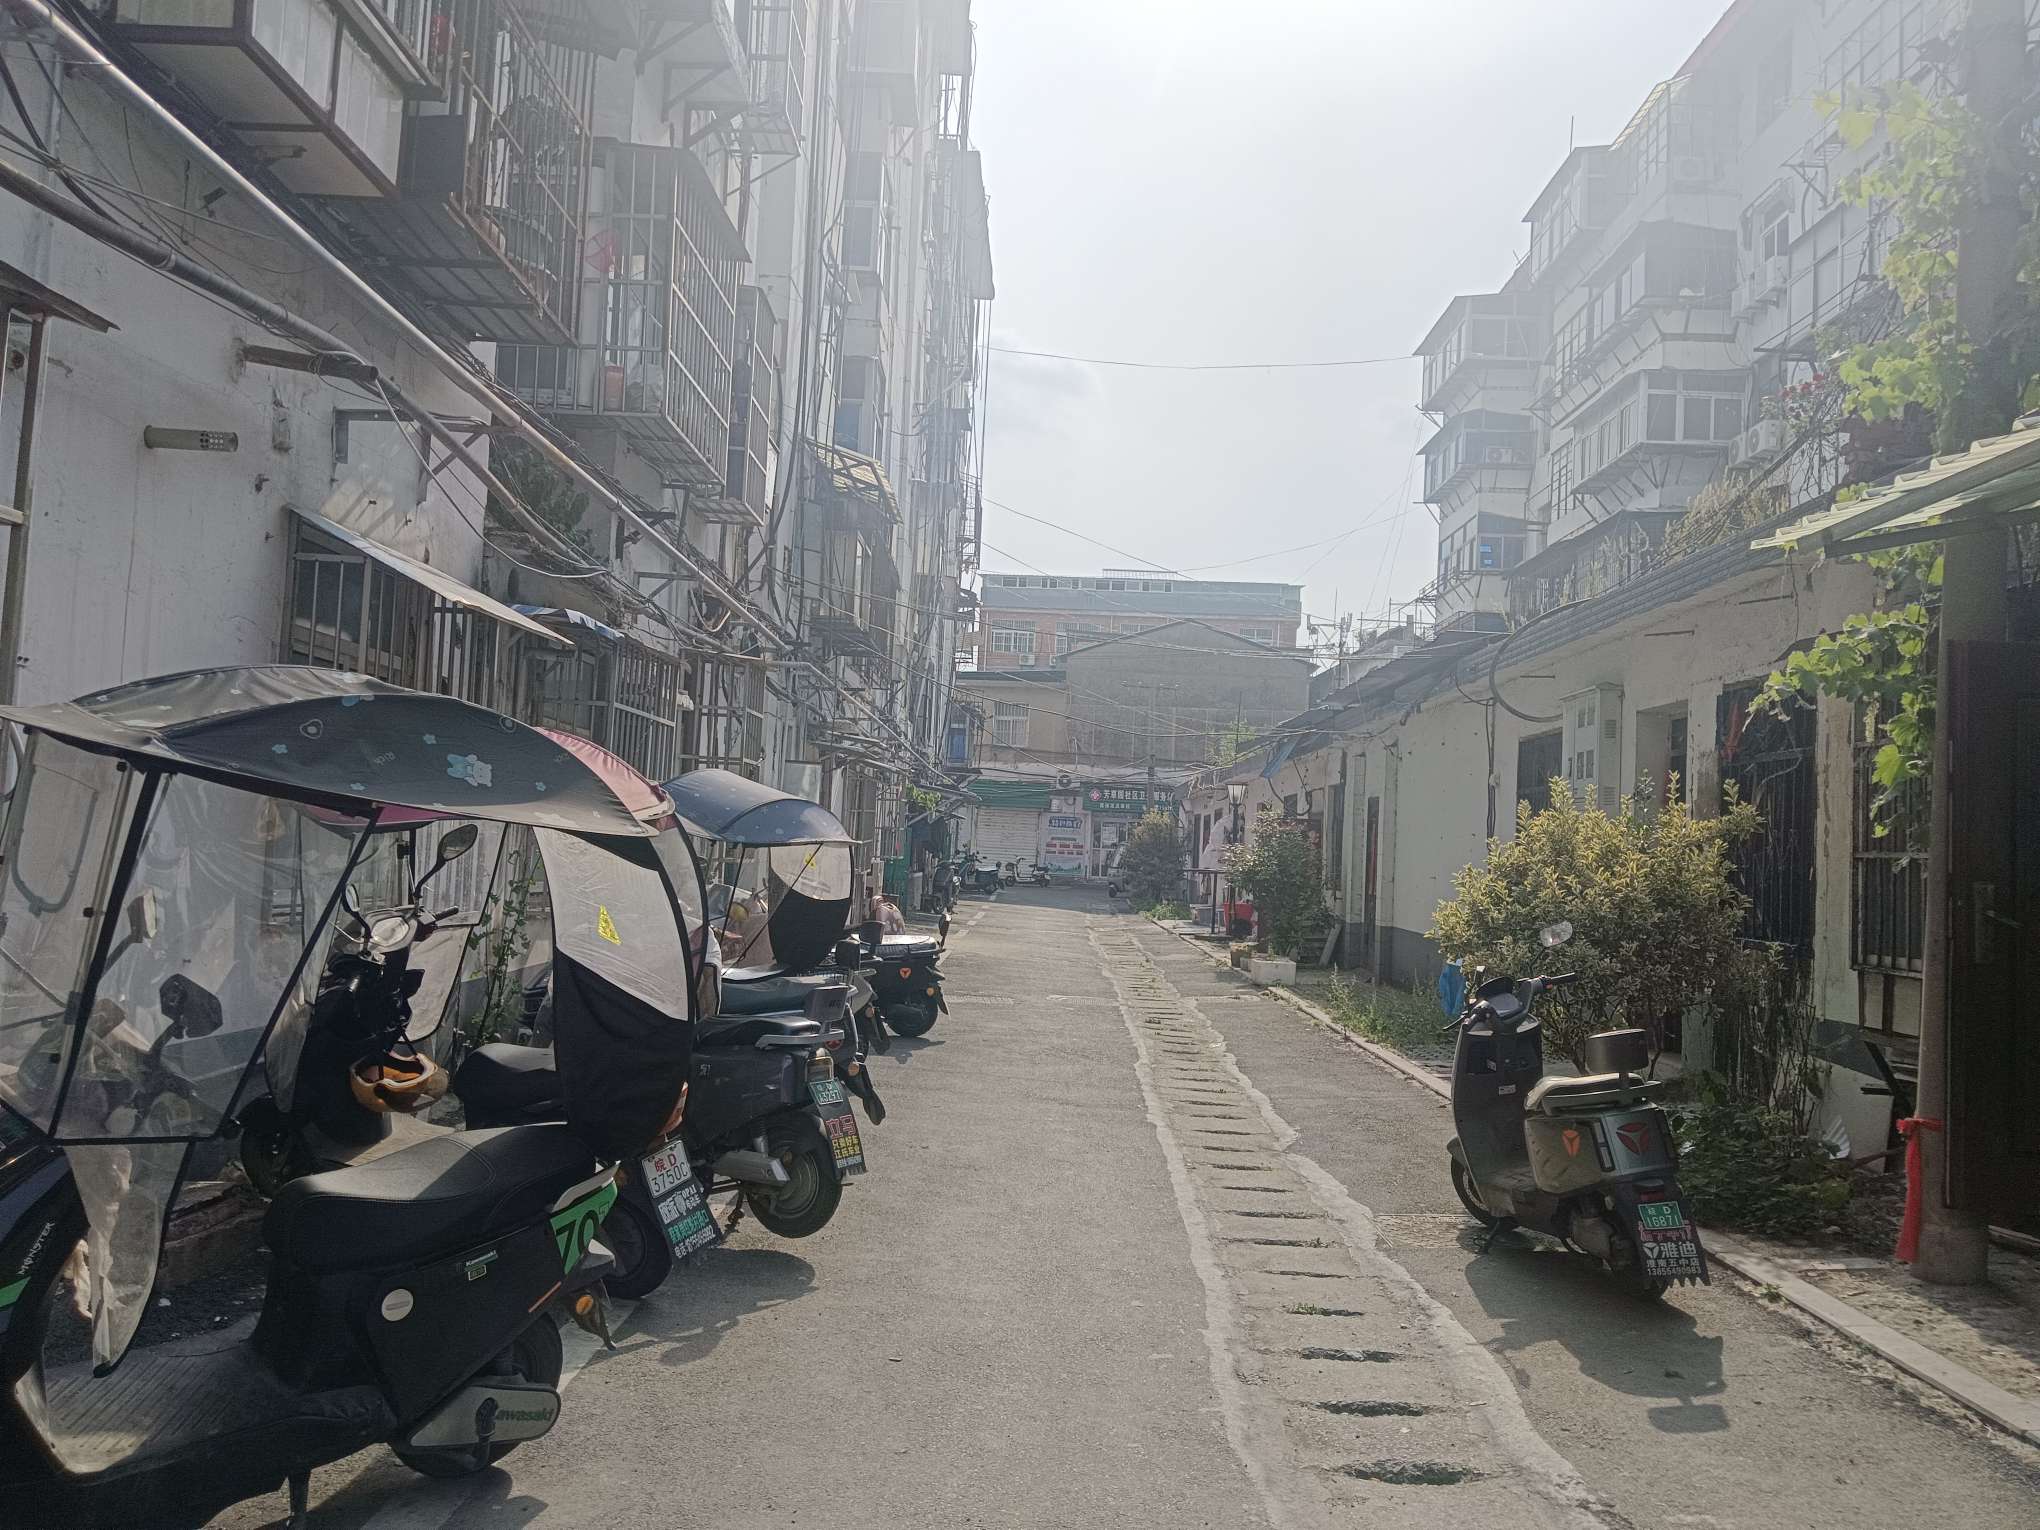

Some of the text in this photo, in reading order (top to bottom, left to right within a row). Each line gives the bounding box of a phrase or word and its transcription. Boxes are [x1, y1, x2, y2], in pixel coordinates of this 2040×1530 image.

[654, 1153, 677, 1173] 皖D
[1647, 1215, 1680, 1228] 16871
[16, 1222, 56, 1275] MONSTER
[1659, 1241, 1698, 1258] 雅迪
[496, 1408, 555, 1422] awasaki
